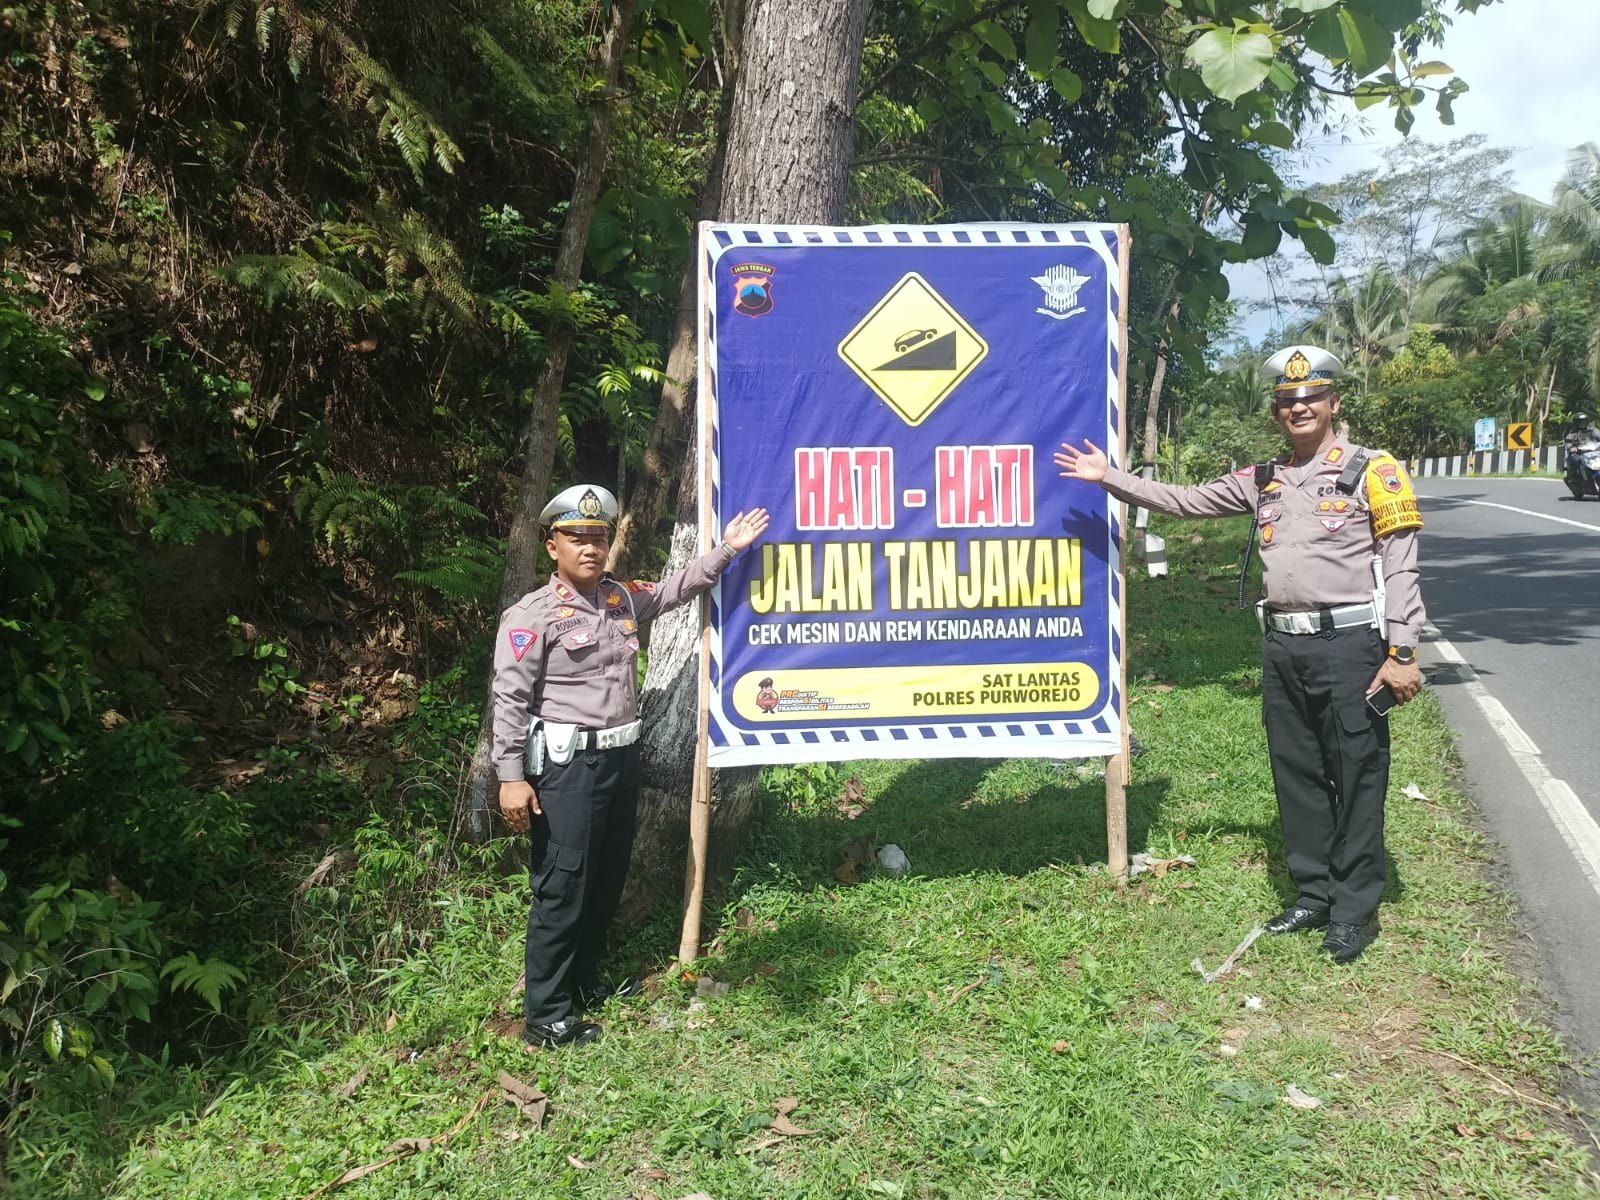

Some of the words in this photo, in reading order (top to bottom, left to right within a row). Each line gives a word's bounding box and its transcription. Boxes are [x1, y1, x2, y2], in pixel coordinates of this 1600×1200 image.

[795, 447, 894, 530] HATI
[935, 444, 1034, 528] HATI
[751, 543, 873, 613] JALAN
[884, 539, 1082, 609] TANJAKAN
[748, 624, 782, 646] CEK
[787, 621, 843, 645] MESIN
[846, 620, 882, 643] DAN
[886, 619, 922, 642] REM
[926, 617, 1031, 640] KENDARAAN
[1035, 616, 1083, 638] ANDA
[983, 674, 1012, 688] SAT
[1018, 672, 1080, 687] LANTAS
[913, 691, 974, 706] POLRES
[980, 688, 1080, 704] PURWOREJO
